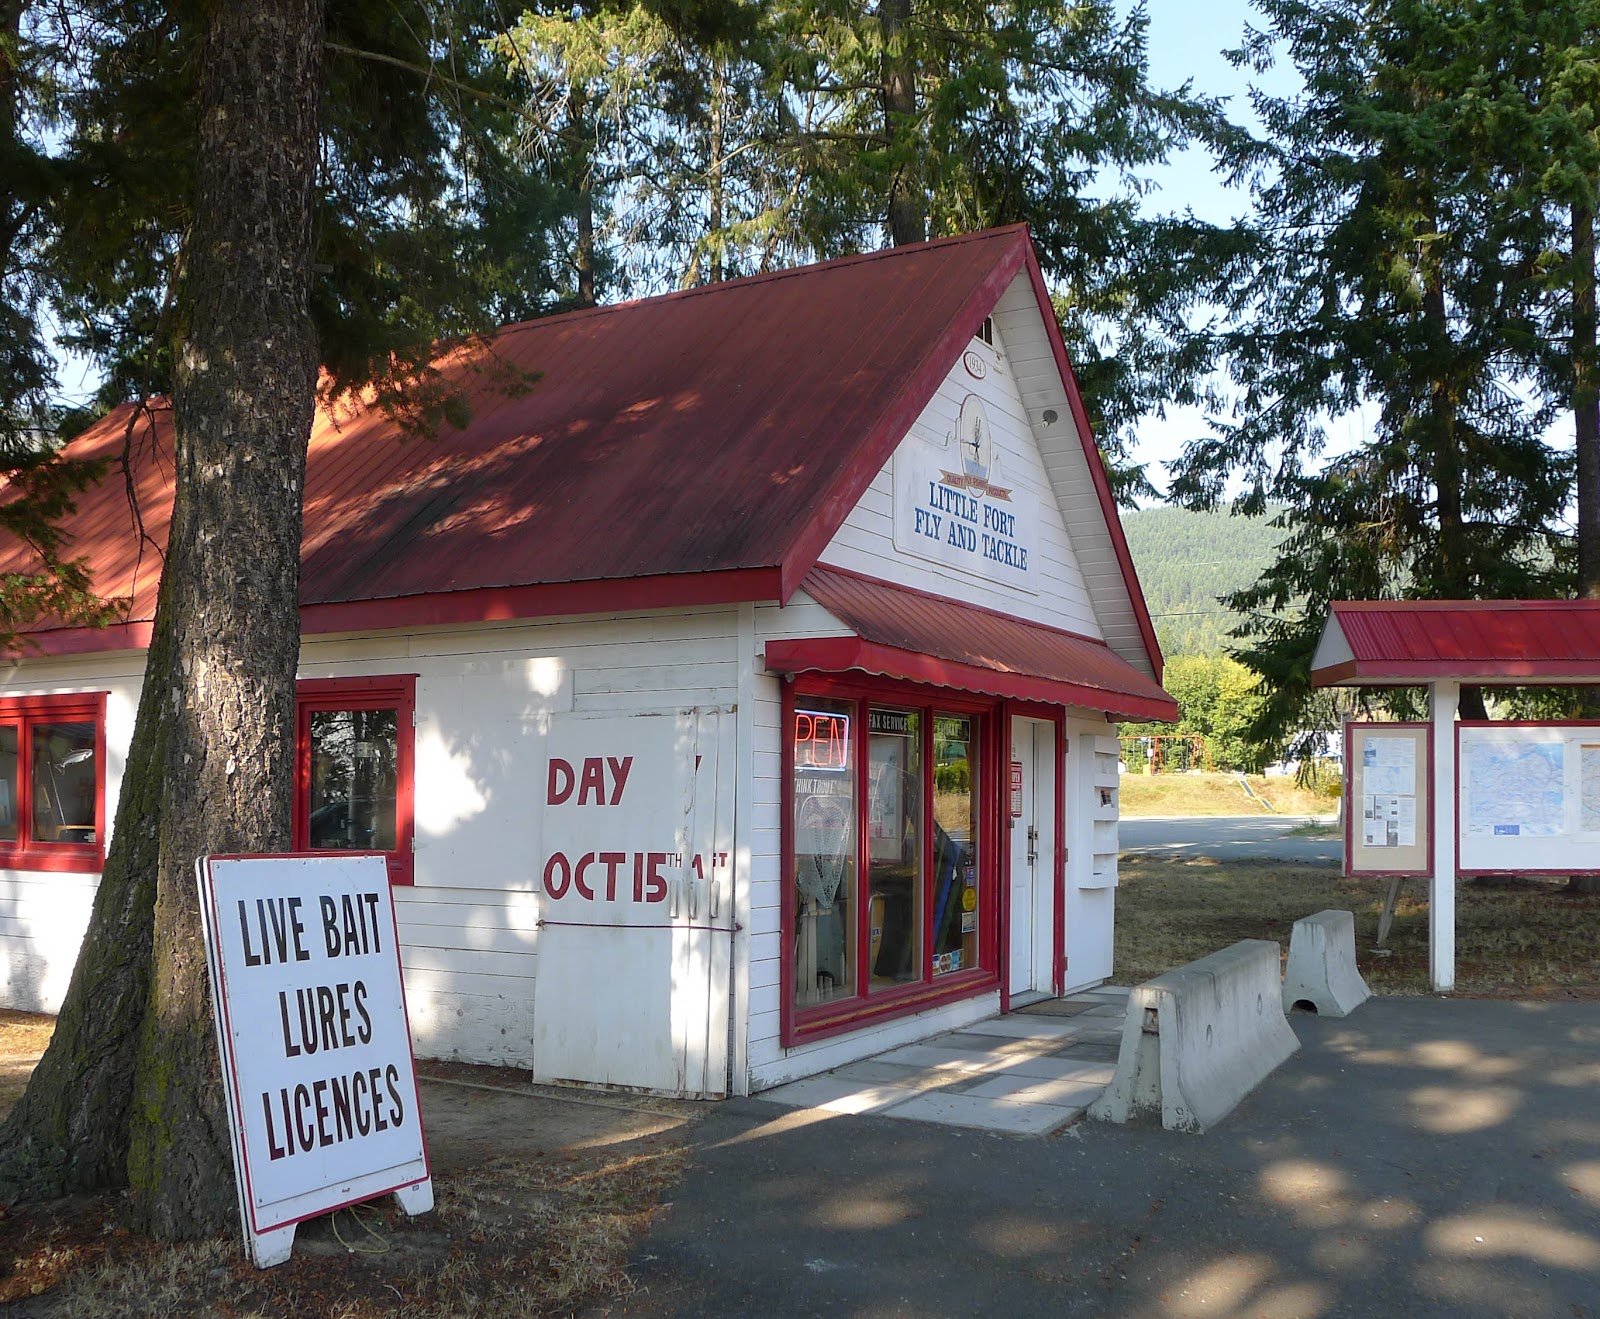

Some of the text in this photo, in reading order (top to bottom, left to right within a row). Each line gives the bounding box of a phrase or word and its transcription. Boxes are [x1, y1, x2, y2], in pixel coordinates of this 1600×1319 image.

[914, 507, 1028, 571] FLY AND TACKLE
[929, 481, 1016, 538] LITTLE FORT
[794, 714, 847, 768] PEN
[546, 756, 634, 806] DAY
[543, 851, 626, 901] OCT
[237, 892, 382, 967] LIVE BAIT
[278, 980, 373, 1058] LURES
[261, 1063, 404, 1161] LICENCES
